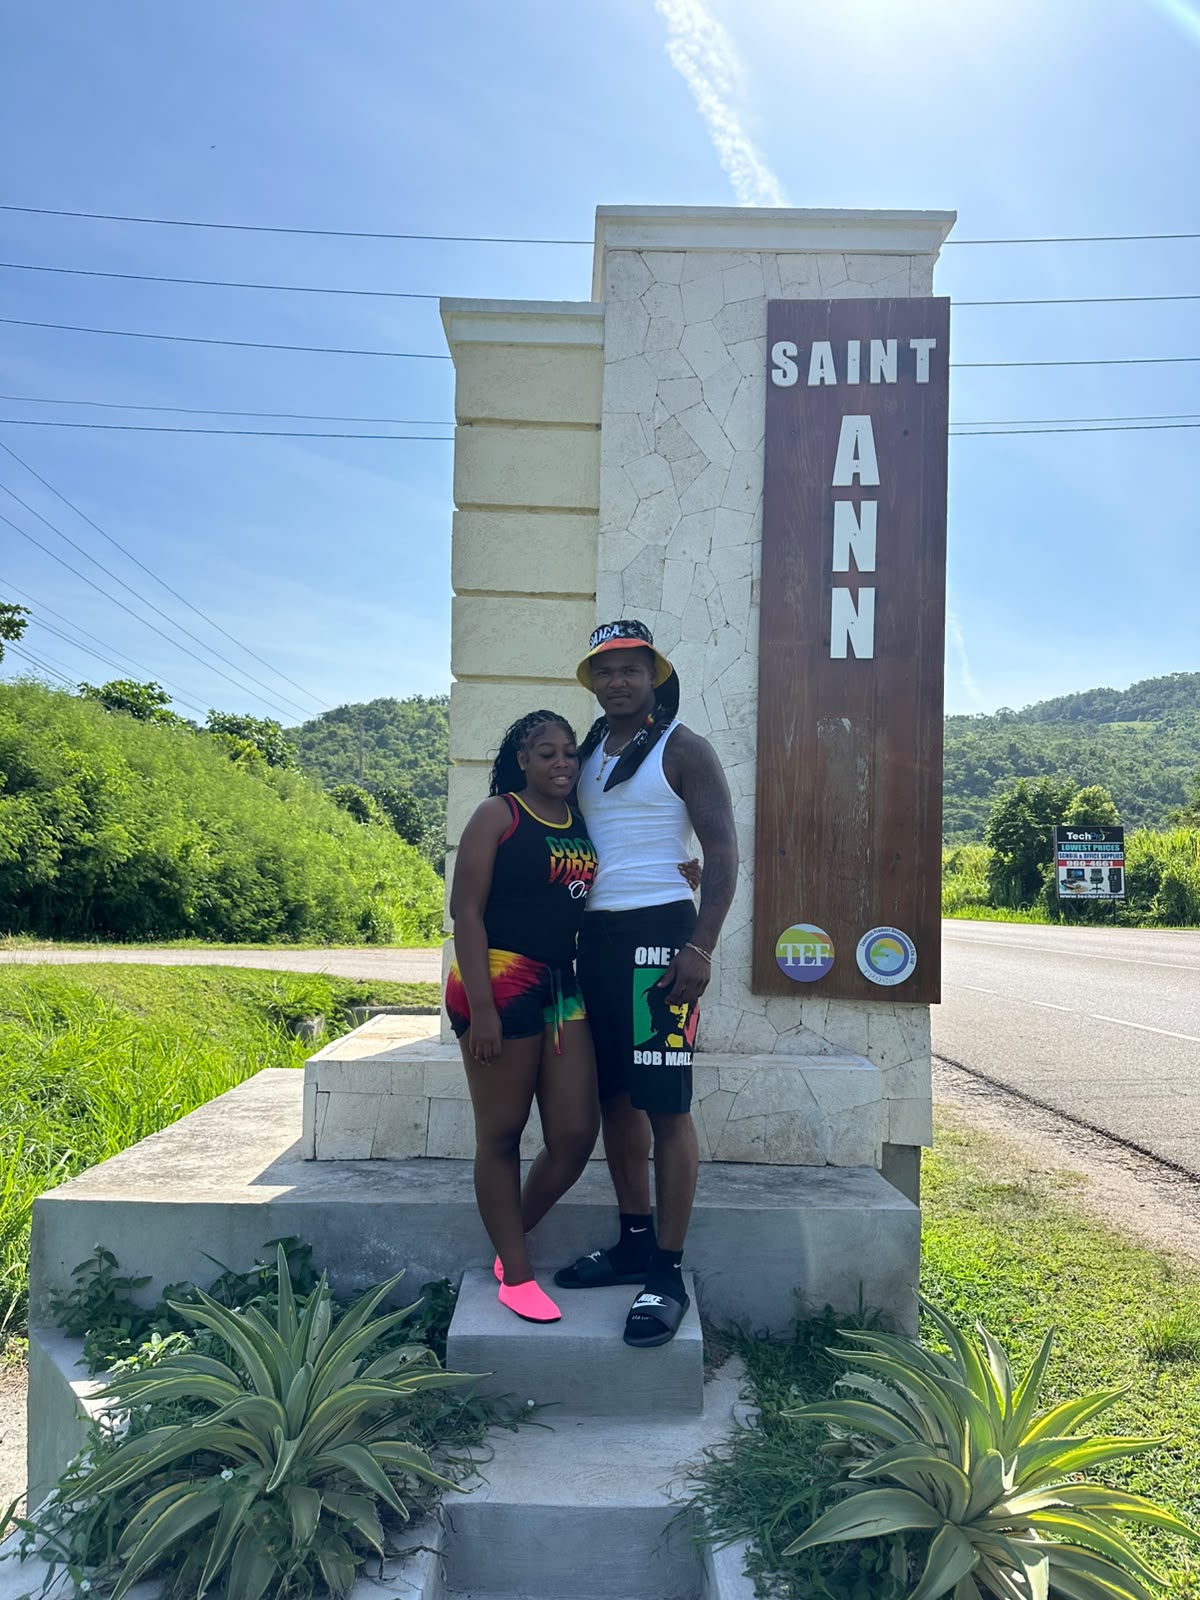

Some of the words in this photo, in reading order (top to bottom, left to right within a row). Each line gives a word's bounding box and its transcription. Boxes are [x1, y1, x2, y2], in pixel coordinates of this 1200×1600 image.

[771, 338, 937, 388] SAINT
[830, 414, 881, 660] ANN
[634, 946, 671, 966] ONE
[780, 943, 830, 967] TEF
[633, 1050, 663, 1066] BOB
